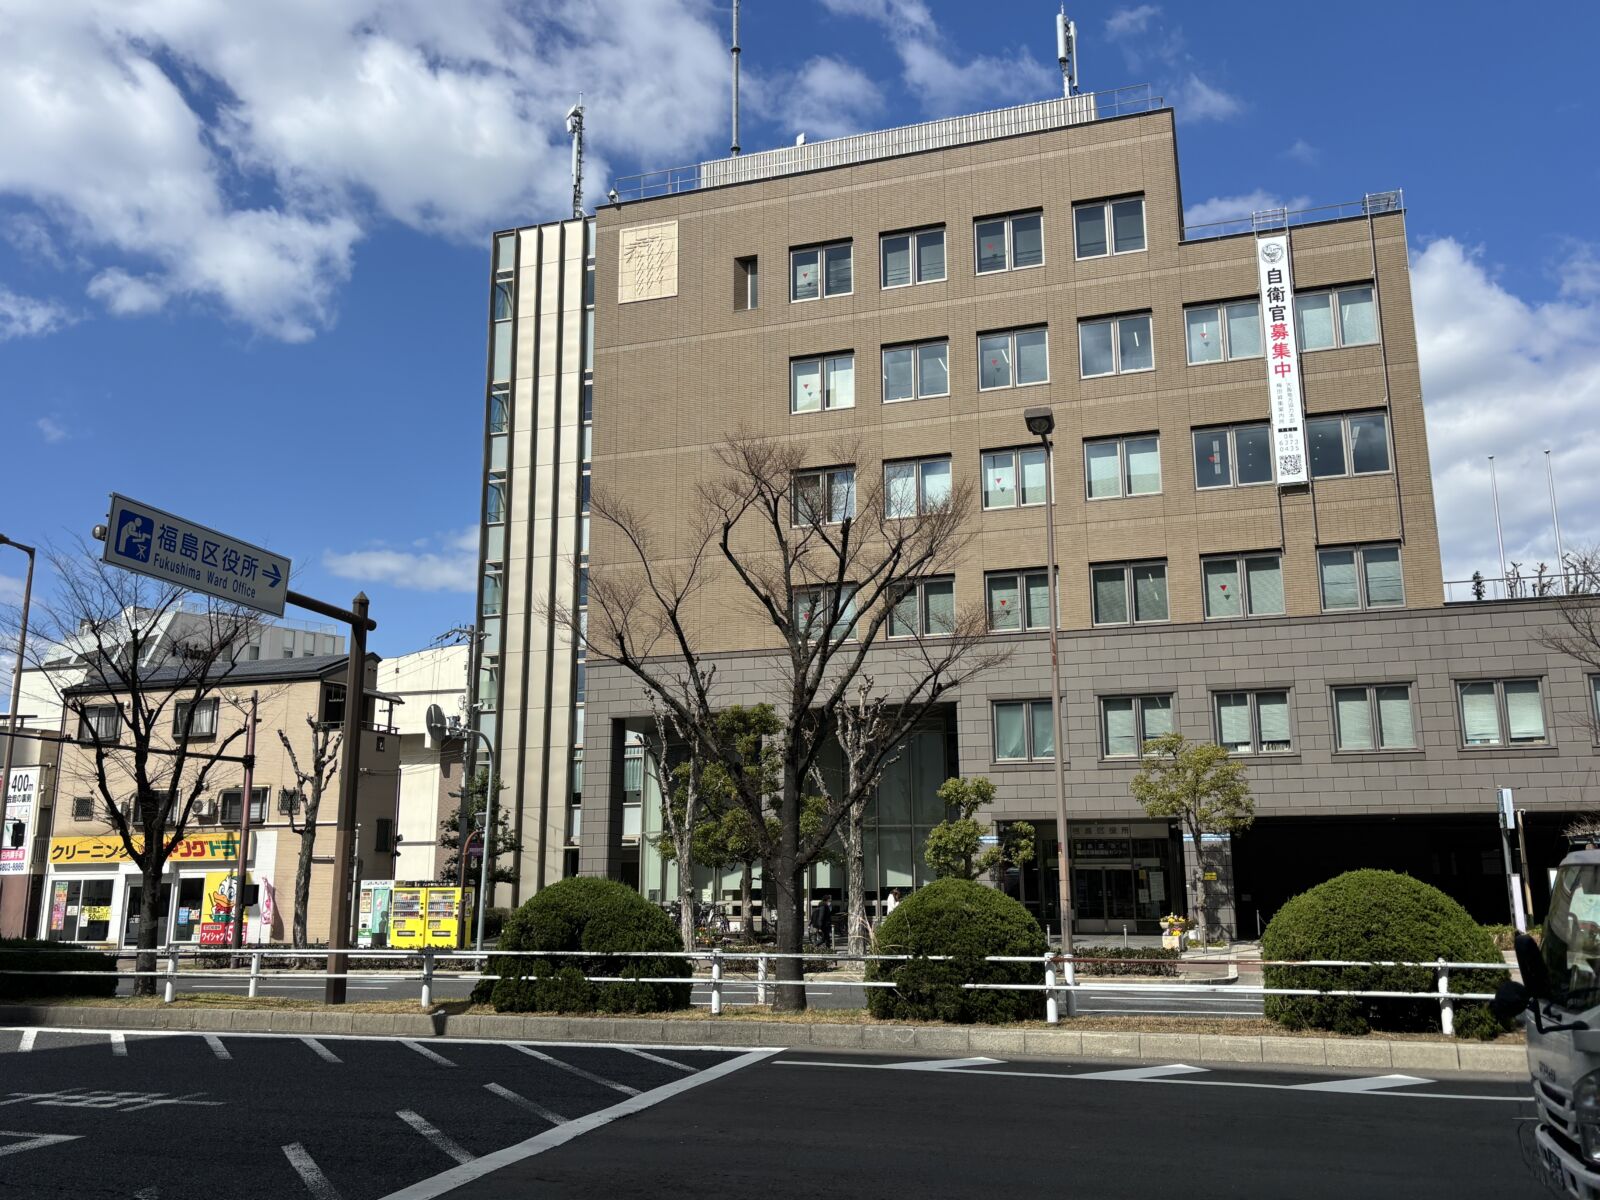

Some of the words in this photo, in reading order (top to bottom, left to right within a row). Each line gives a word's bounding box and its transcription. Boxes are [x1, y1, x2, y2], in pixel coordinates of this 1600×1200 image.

[1267, 268, 1292, 378] 自衛官募集中
[153, 552, 201, 581] Fukushima
[207, 570, 228, 590] Ward
[232, 579, 256, 599] Office
[158, 524, 260, 581] 福島区役所
[11, 774, 34, 792] 400m
[201, 931, 225, 942] ワイシャツ
